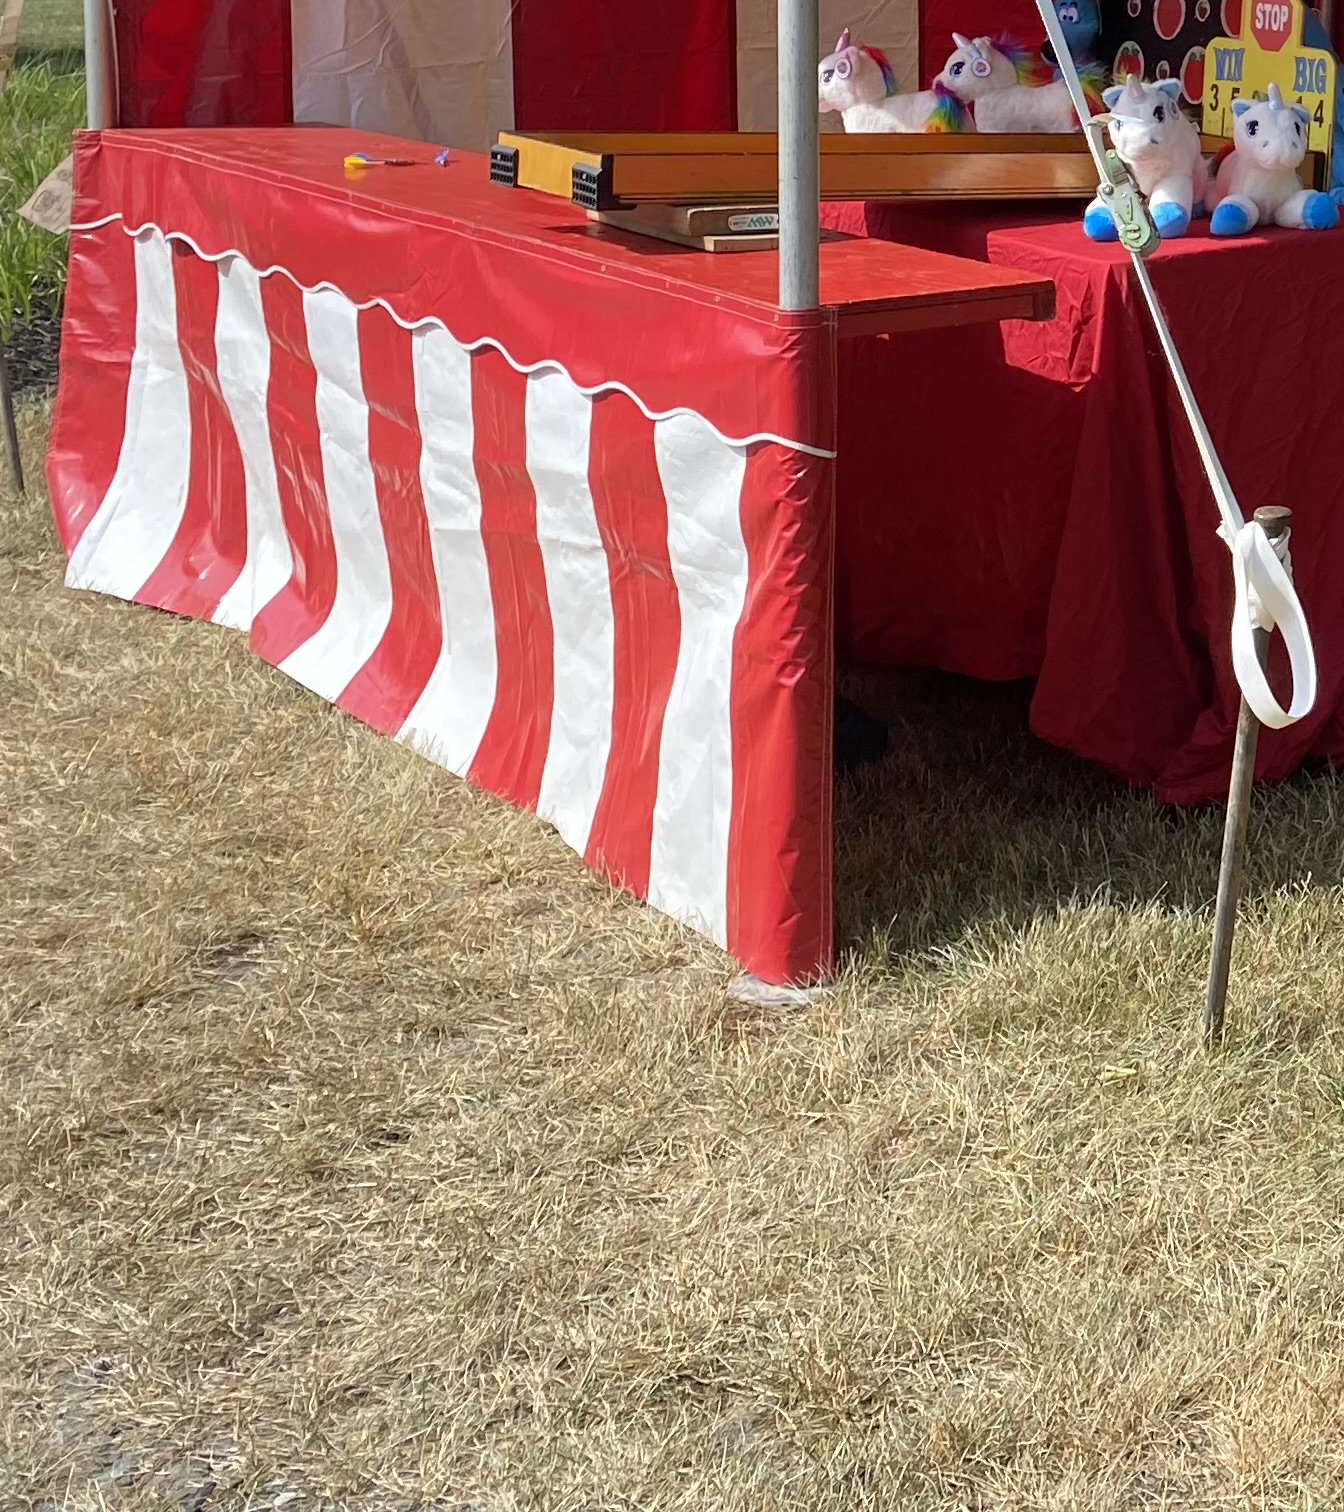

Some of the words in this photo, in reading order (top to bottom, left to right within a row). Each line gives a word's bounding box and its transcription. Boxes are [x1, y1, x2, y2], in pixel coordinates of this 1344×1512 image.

[1255, 2, 1289, 32] STOP
[1213, 46, 1246, 82] WIN
[1292, 55, 1327, 94] BIG
[1209, 83, 1219, 112] 3
[1313, 99, 1325, 129] 4
